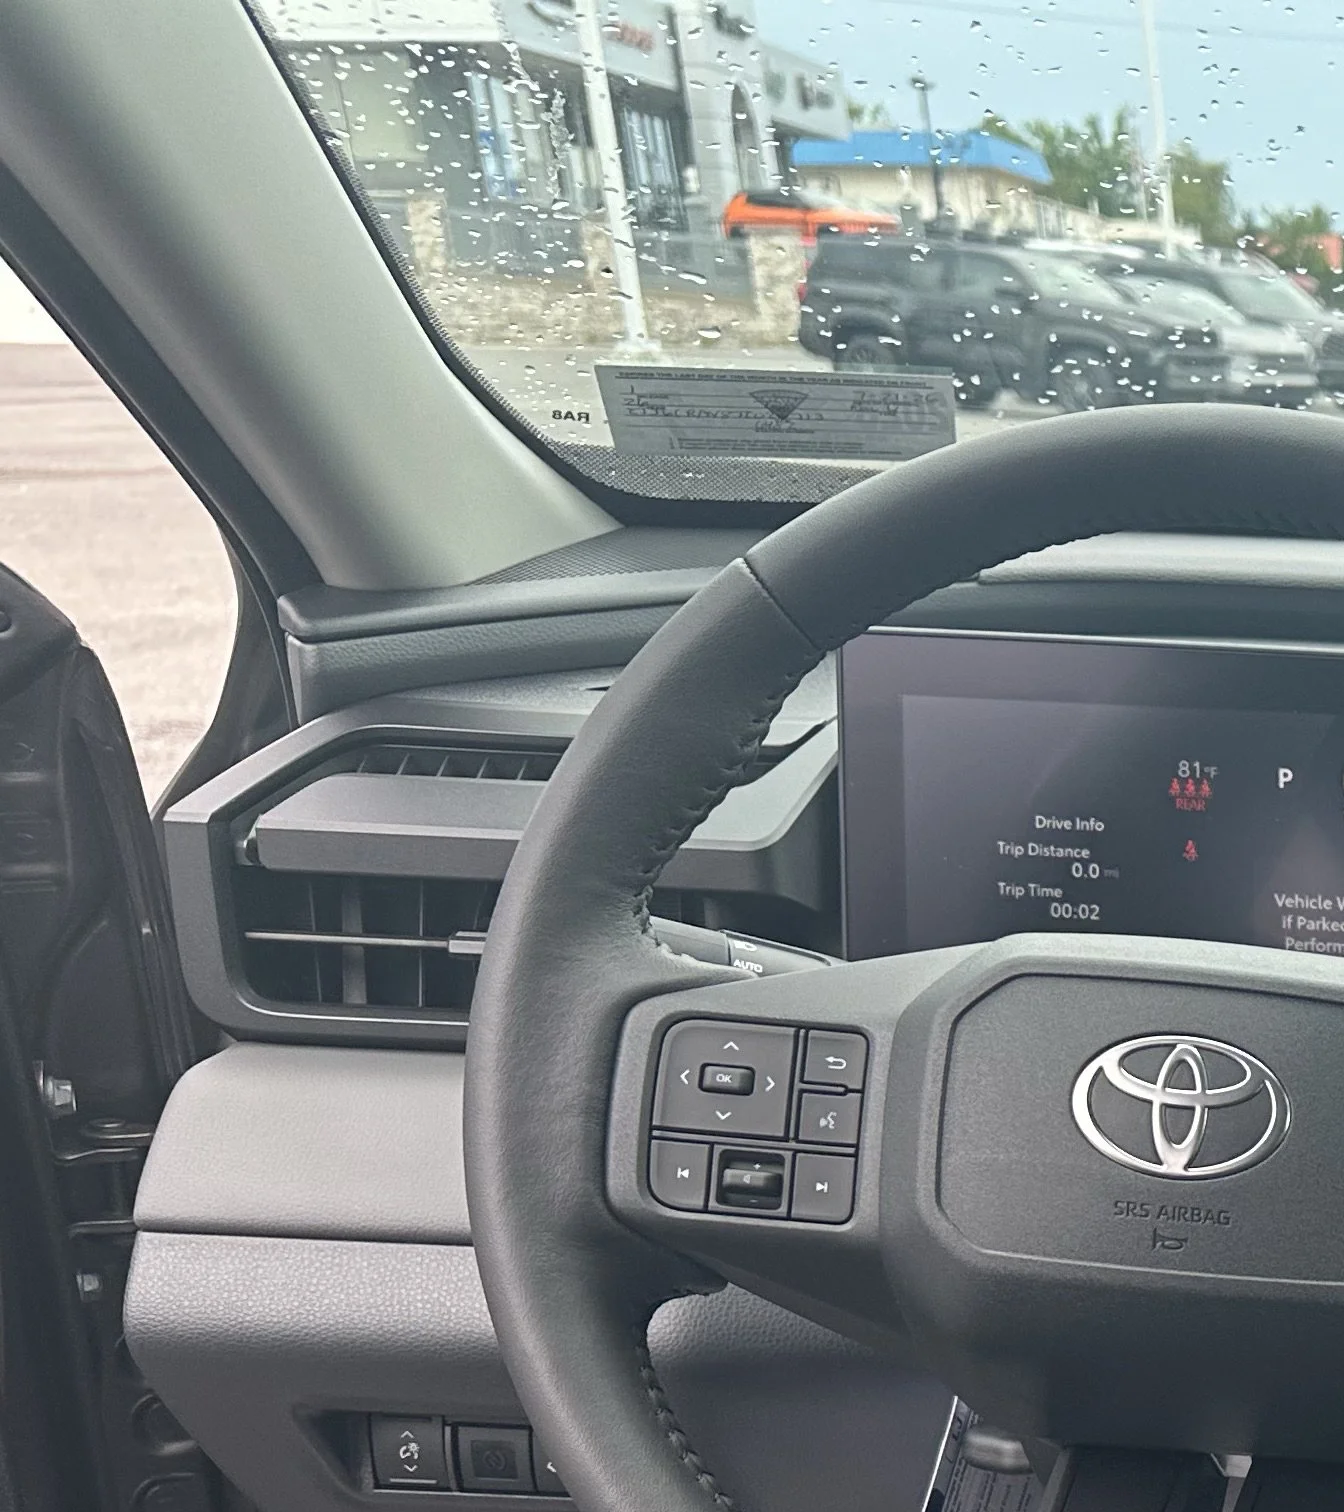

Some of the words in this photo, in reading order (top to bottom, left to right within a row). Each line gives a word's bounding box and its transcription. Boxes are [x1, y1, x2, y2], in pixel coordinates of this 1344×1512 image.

[1278, 768, 1293, 788] P
[1175, 799, 1206, 811] REAR
[1035, 815, 1072, 830] Drive
[1076, 817, 1104, 831] Info
[997, 841, 1024, 858] Trip
[1028, 843, 1090, 859] Distance
[1072, 862, 1099, 878] 0.0
[998, 882, 1025, 899] Trip
[1028, 884, 1063, 898] Time
[1274, 893, 1332, 910] Vehicle
[1051, 902, 1100, 920] 00:02
[733, 959, 763, 973] AUTO
[716, 1073, 732, 1083] OK
[1113, 1200, 1150, 1218] SRS
[1156, 1204, 1231, 1226] AIRBAG
